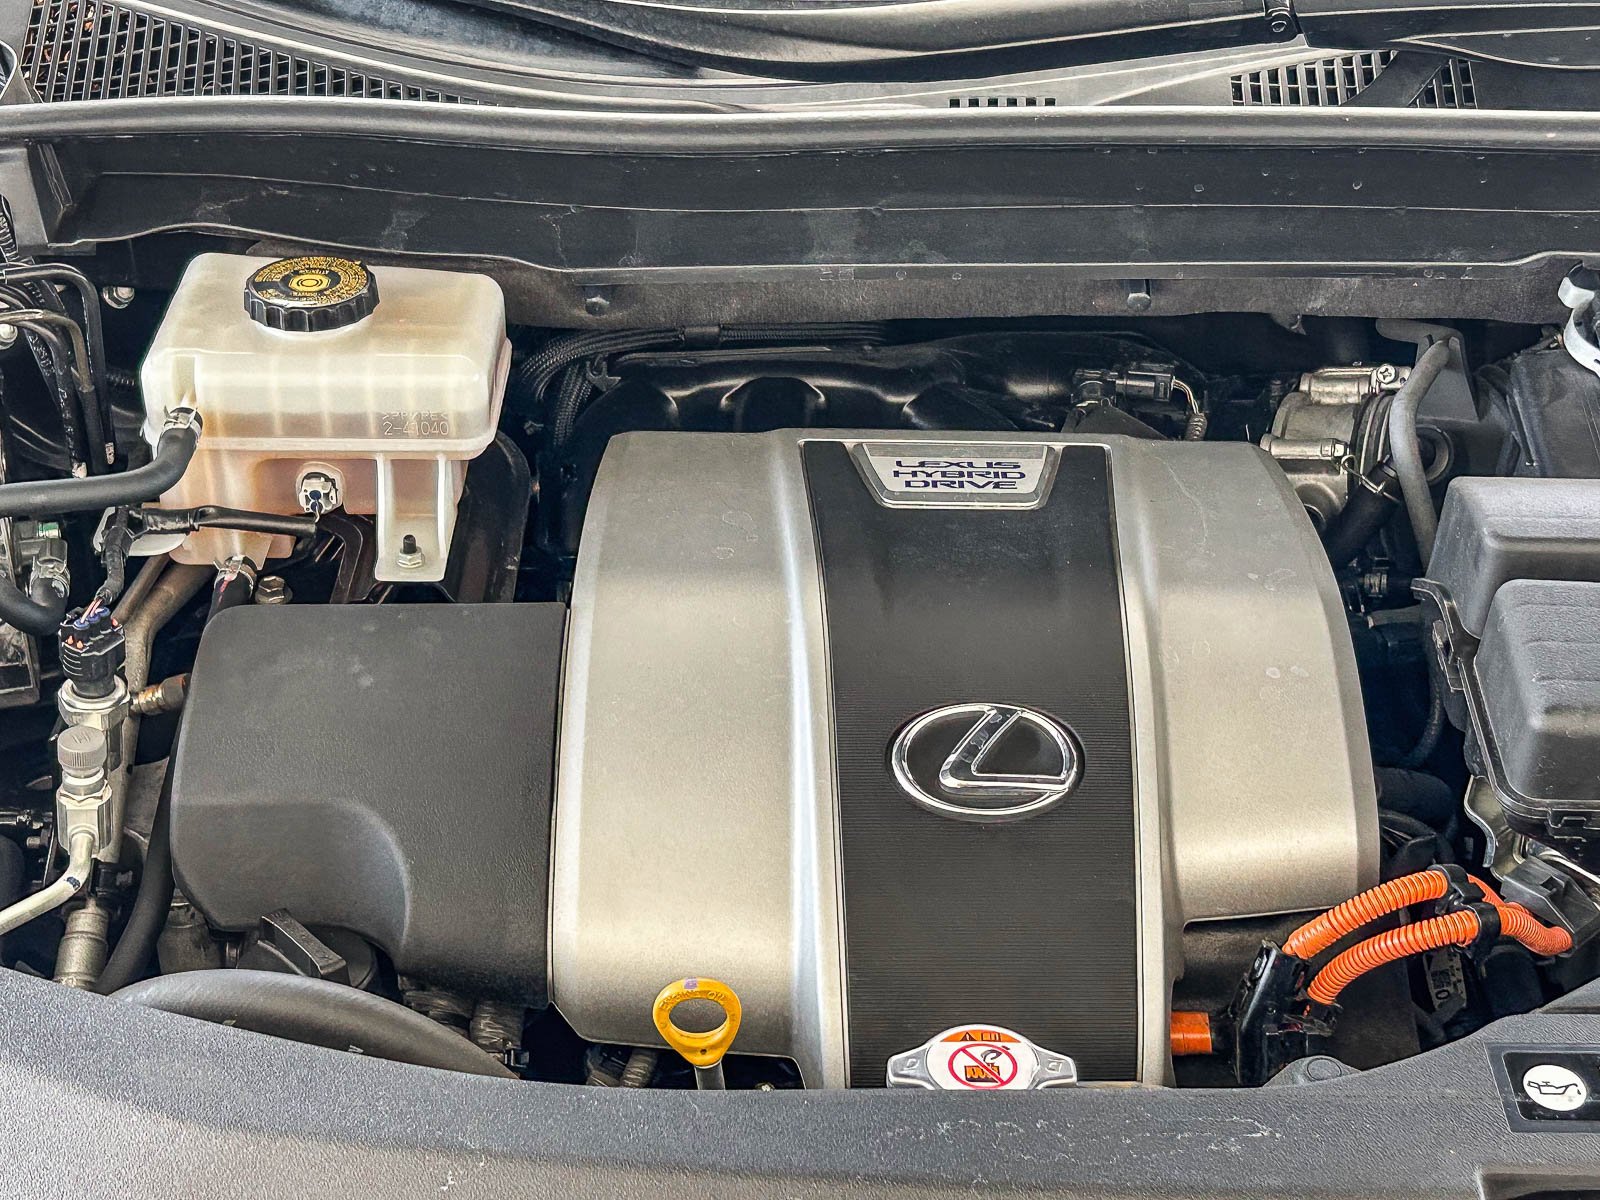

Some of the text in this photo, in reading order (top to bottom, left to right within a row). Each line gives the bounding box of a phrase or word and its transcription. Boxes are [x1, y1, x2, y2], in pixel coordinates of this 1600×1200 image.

[895, 460, 1021, 469] LEXUS
[893, 470, 1026, 479] HYBRID
[904, 480, 1018, 490] DRIVE
